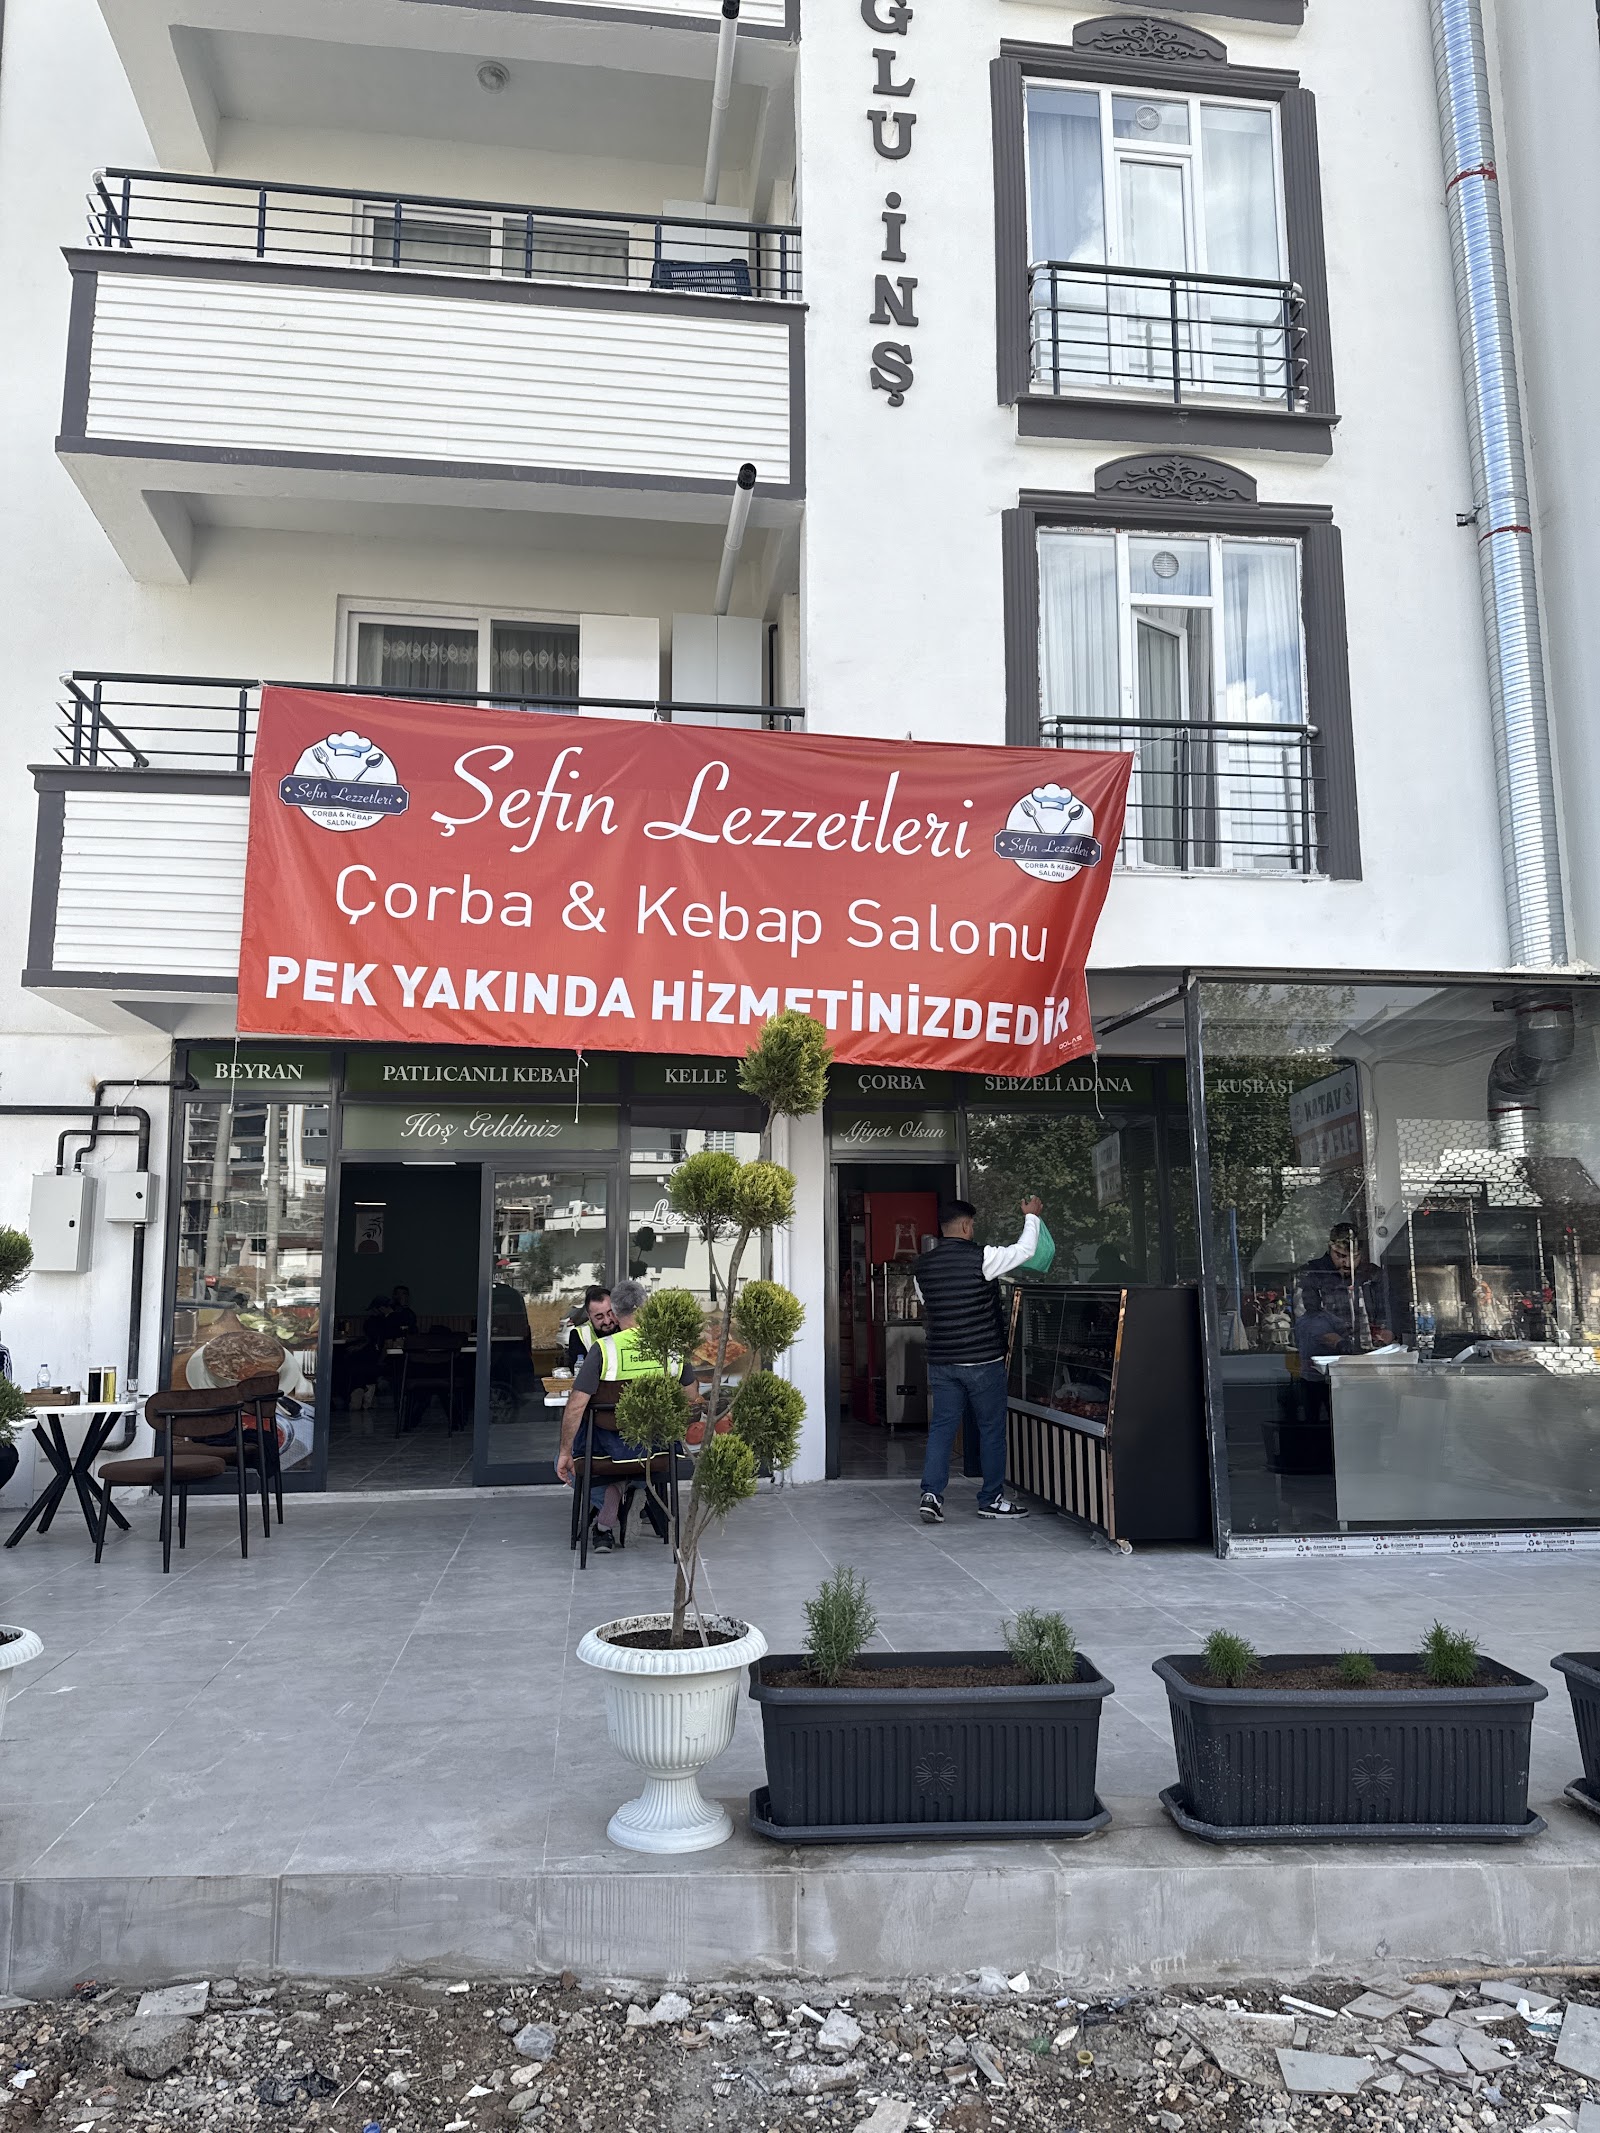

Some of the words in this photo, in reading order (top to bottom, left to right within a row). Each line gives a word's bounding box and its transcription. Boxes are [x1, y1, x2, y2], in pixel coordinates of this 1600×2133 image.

[331, 787, 393, 805] Lezzetleri
[430, 744, 618, 853] Şefin
[643, 760, 973, 860] Lezzetleri
[346, 812, 373, 821] KEBAP
[335, 864, 533, 926] Çorba
[561, 880, 607, 933] &
[637, 885, 822, 959] Kebap
[846, 898, 1048, 963] Salonu
[265, 955, 378, 1006] PEK
[394, 963, 636, 1019] YAKINDA
[214, 1062, 304, 1080] BEYRAN
[382, 1065, 508, 1083] PATLICANLI
[512, 1066, 579, 1084] KEBAP
[664, 1068, 728, 1084] KELLE
[858, 1074, 926, 1094] ÇORBA
[984, 1073, 1066, 1092] SEBZELİ
[1068, 1077, 1133, 1093] ADANA
[1217, 1078, 1295, 1098] KUŞBAŞI
[400, 1112, 458, 1144] Hoş
[463, 1110, 563, 1139] Geldiniz
[839, 1119, 893, 1143] Afiyet
[898, 1119, 947, 1139] Olsun
